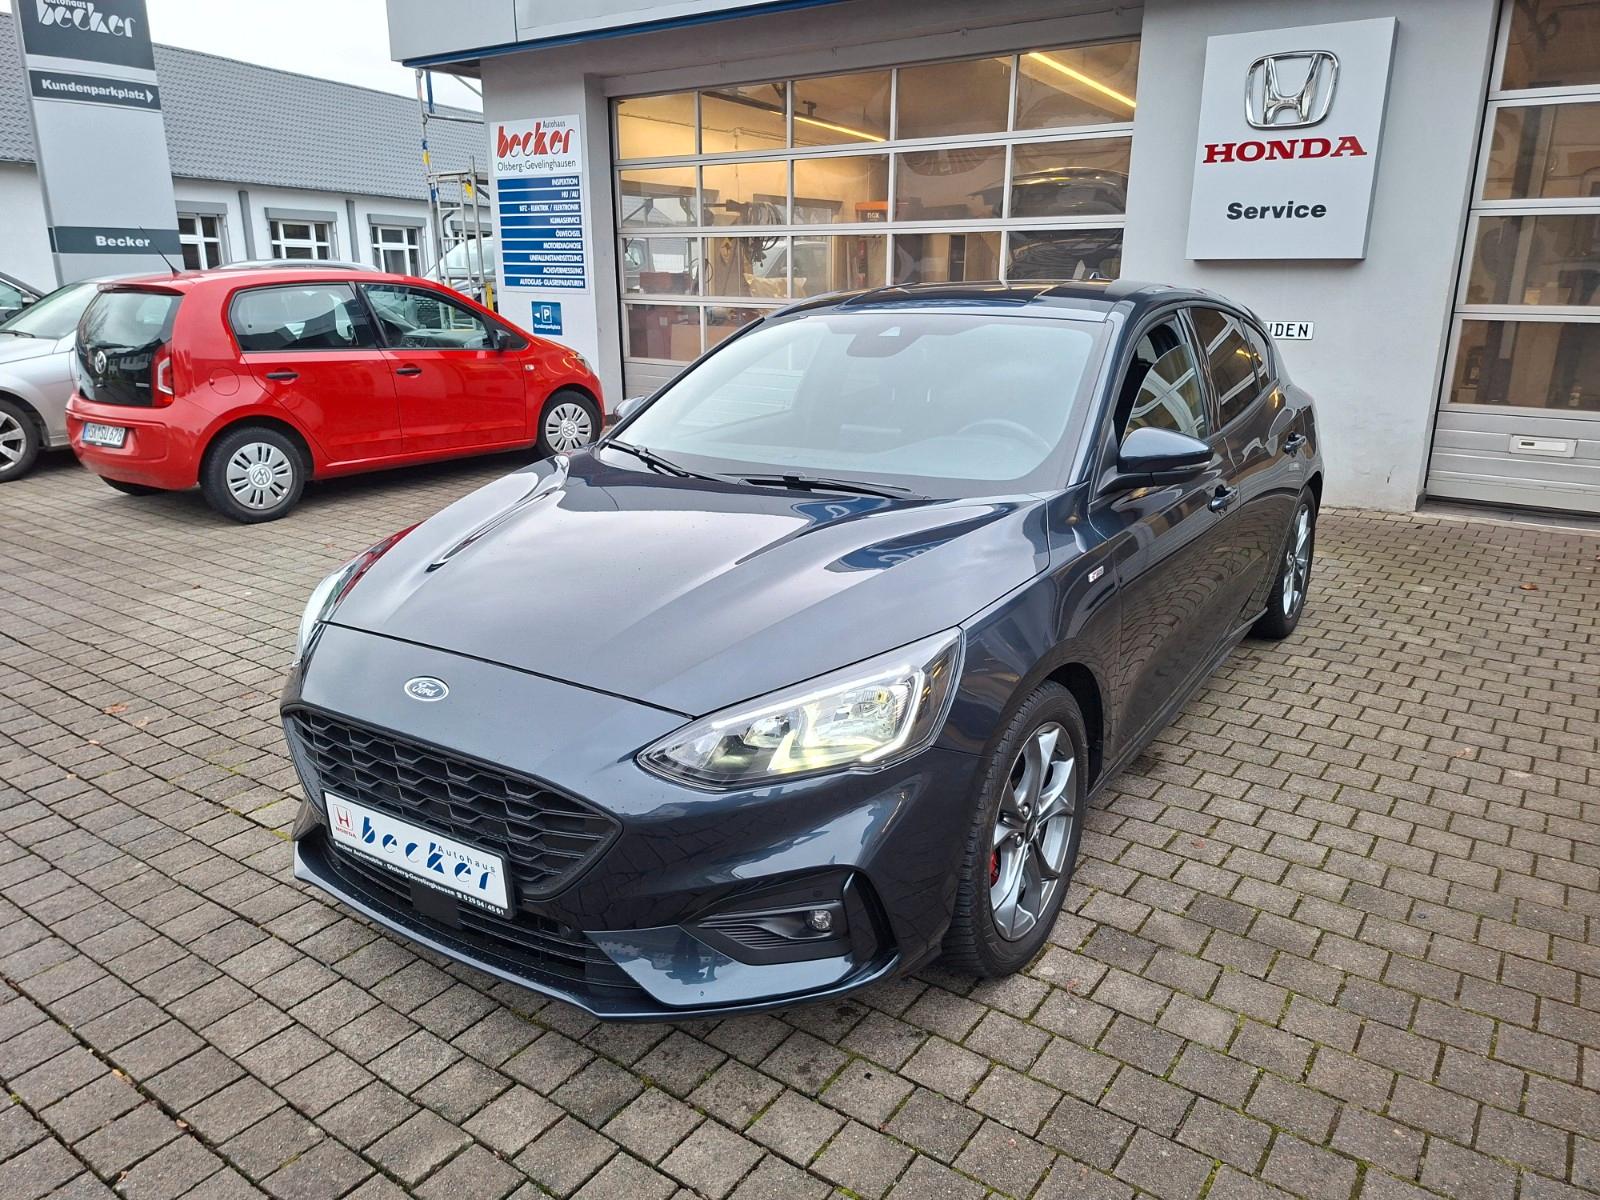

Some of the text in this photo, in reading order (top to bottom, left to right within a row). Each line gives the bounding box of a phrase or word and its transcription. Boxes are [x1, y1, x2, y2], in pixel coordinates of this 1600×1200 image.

[36, 0, 137, 38] becker
[42, 79, 146, 101] Kundenparkplatz
[543, 120, 567, 129] Autohaus
[497, 122, 576, 159] becker
[1202, 135, 1368, 163] HONDA
[497, 159, 577, 173] Olsberg-Gevelinghausen
[551, 178, 579, 187] INSPEKTION
[561, 191, 569, 199] HU
[530, 204, 549, 212] ELEKTRIK
[553, 203, 580, 211] ELEKTRONIK
[1226, 200, 1328, 221] Service
[550, 216, 580, 224] KLIMASERVICE
[555, 228, 581, 237] ÖLWECHSEL
[95, 236, 151, 248] Becker
[542, 241, 582, 250] MOTORDIAGNOSE
[529, 253, 583, 262] UNFALLINSTANDSETZUNG
[542, 266, 583, 275] ACHSVERMESSUNG
[543, 279, 584, 287] GLASREPARATUREN
[411, 681, 440, 697] Ford
[362, 816, 496, 890] becker
[438, 845, 496, 873] Autohaus
